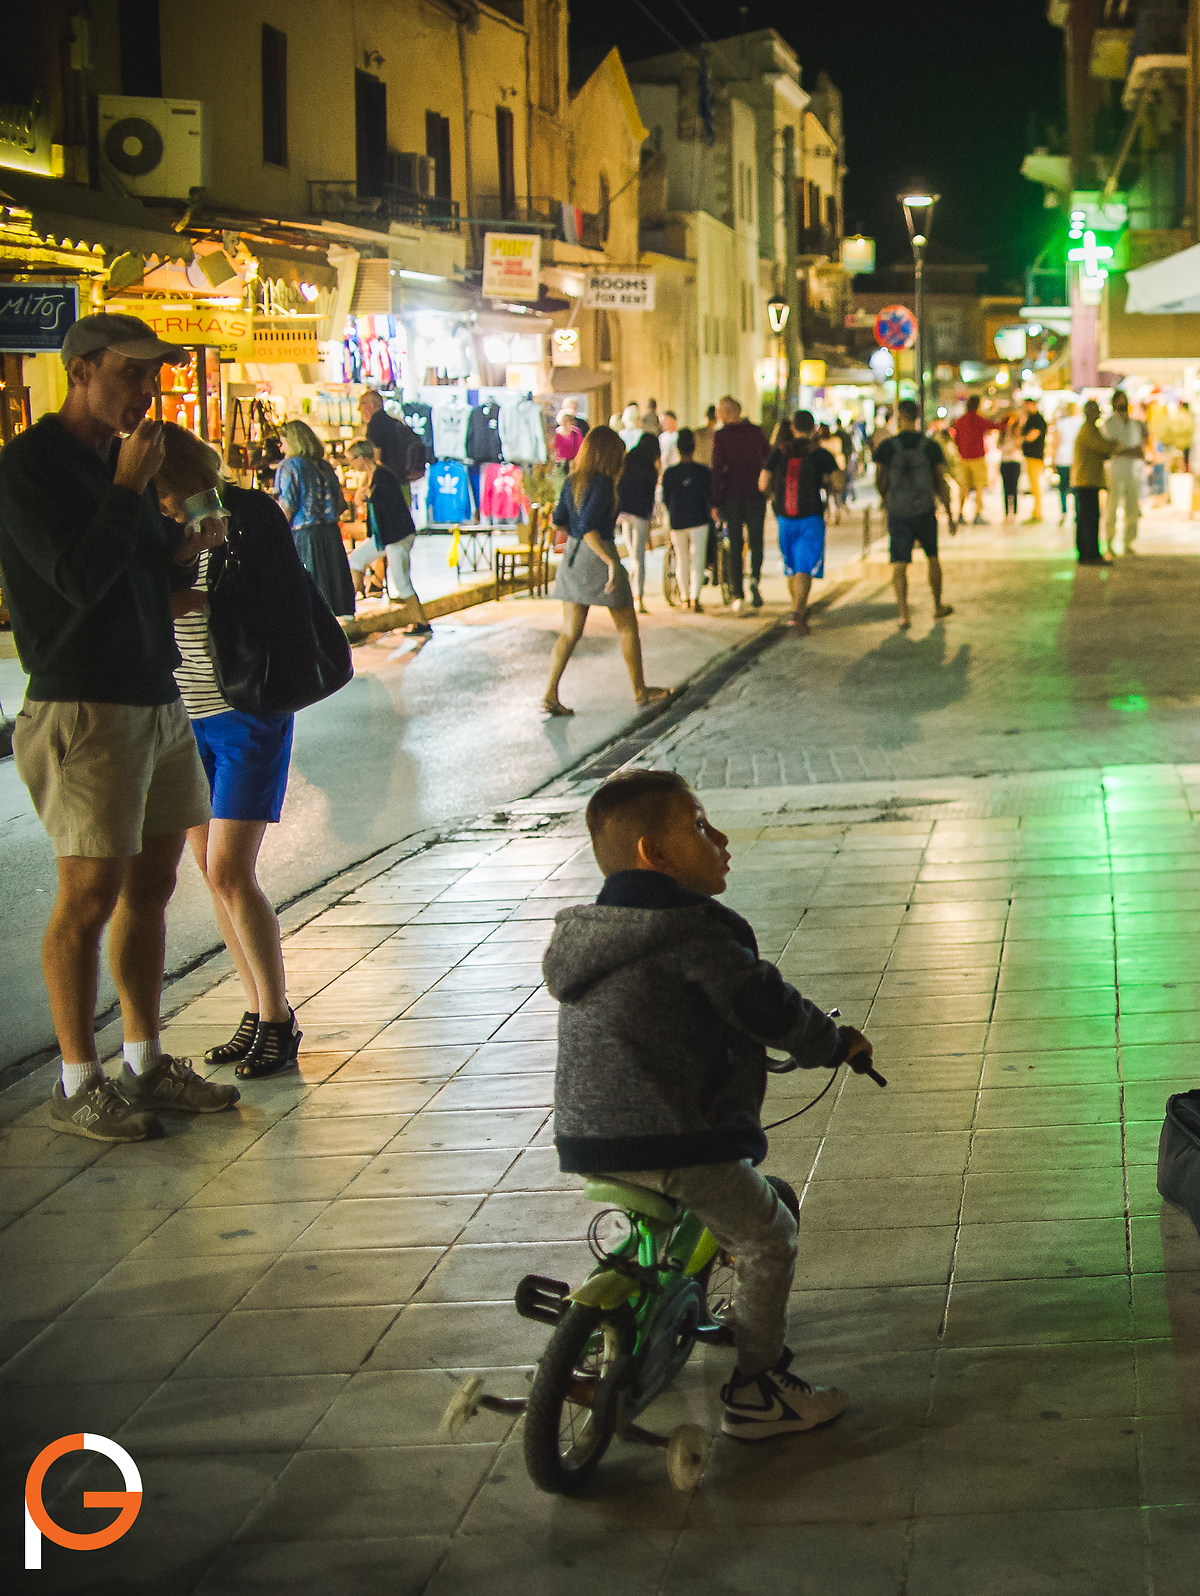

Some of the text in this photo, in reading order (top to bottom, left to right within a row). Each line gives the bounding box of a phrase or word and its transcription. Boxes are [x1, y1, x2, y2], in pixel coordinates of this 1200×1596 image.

[590, 276, 647, 290] ROOMS
[595, 292, 647, 304] FOR RENT
